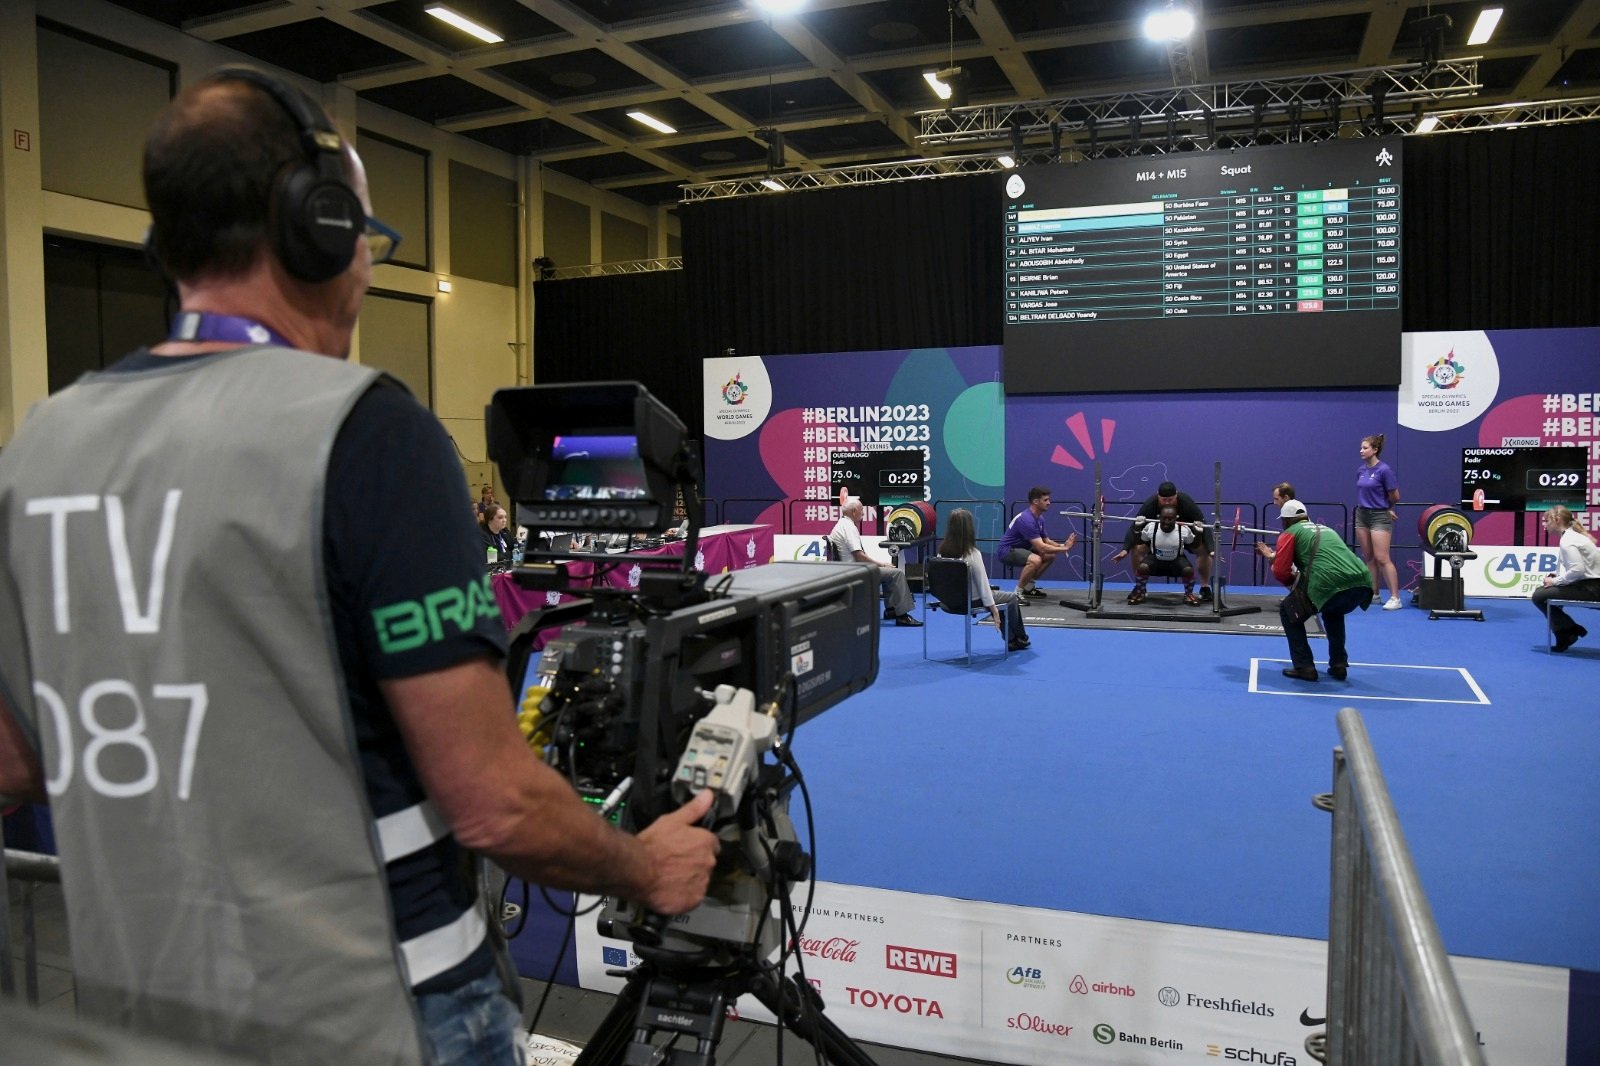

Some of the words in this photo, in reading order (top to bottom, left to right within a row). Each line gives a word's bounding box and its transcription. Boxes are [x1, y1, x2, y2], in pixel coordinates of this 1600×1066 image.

[18, 134, 26, 146] F
[1136, 171, 1155, 181] M14
[1167, 169, 1187, 180] M15
[1221, 165, 1251, 176] Squat
[1327, 216, 1344, 224] 105.0
[1376, 213, 1396, 221] 100.00
[1376, 226, 1396, 234] 100.00
[802, 404, 930, 423] #BERLIN2023
[802, 425, 930, 443] #BERLIN2023
[832, 470, 853, 479] 75.0
[888, 473, 918, 484] 0:29
[1464, 470, 1491, 480] 75.0
[1539, 473, 1579, 486] 0:29
[26, 489, 182, 634] TV
[1496, 552, 1558, 572] AfB
[834, 911, 885, 924] PARTNERS
[1006, 933, 1063, 948] PARTNERS
[889, 949, 954, 975] REWE
[1012, 966, 1042, 979] AfB
[1092, 982, 1136, 997] airbnb
[845, 987, 944, 1019] TOYOTA
[1186, 993, 1275, 1017] Freshfields
[657, 1014, 694, 1026] sachtler
[1007, 1012, 1073, 1037] s.Oliver
[1119, 1031, 1147, 1047] Bahn
[1150, 1037, 1183, 1051] Berlin
[1224, 1047, 1297, 1066] schufa
